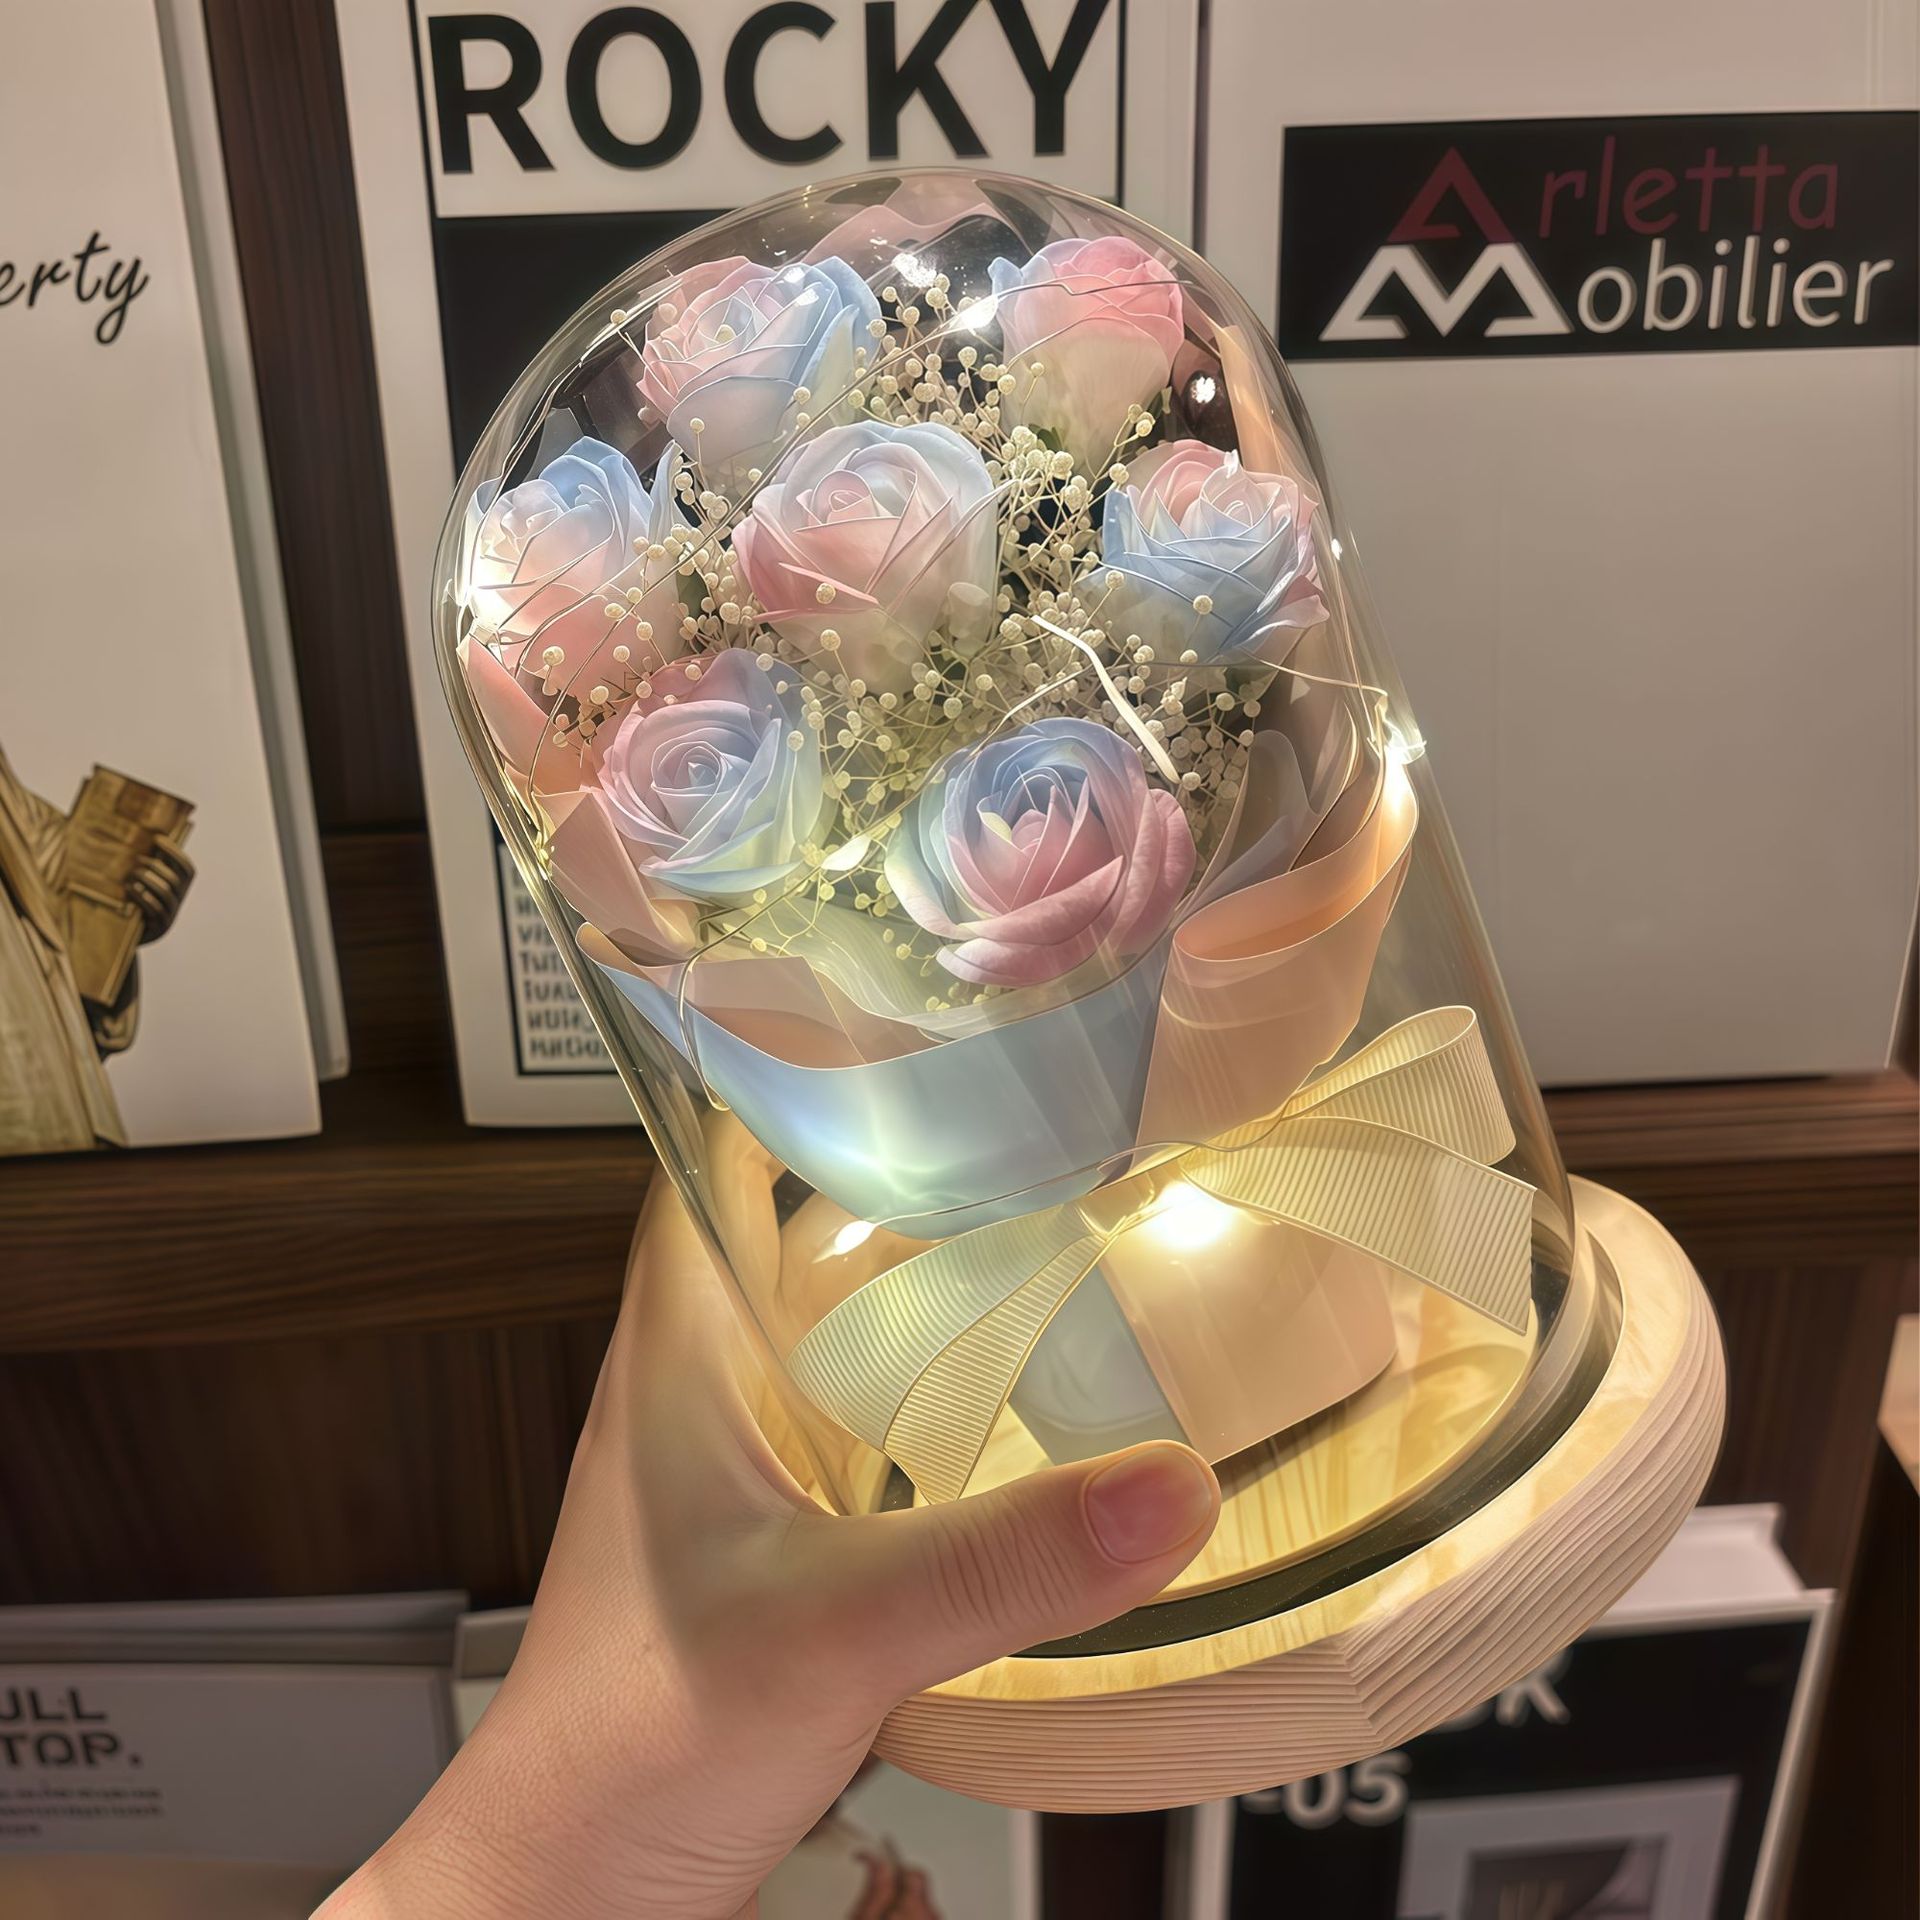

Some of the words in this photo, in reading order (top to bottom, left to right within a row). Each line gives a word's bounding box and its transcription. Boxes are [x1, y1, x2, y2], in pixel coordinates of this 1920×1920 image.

[428, 0, 1108, 174] ROCKY
[1385, 136, 1838, 244] Arletta
[1318, 236, 1895, 342] Mobilier
